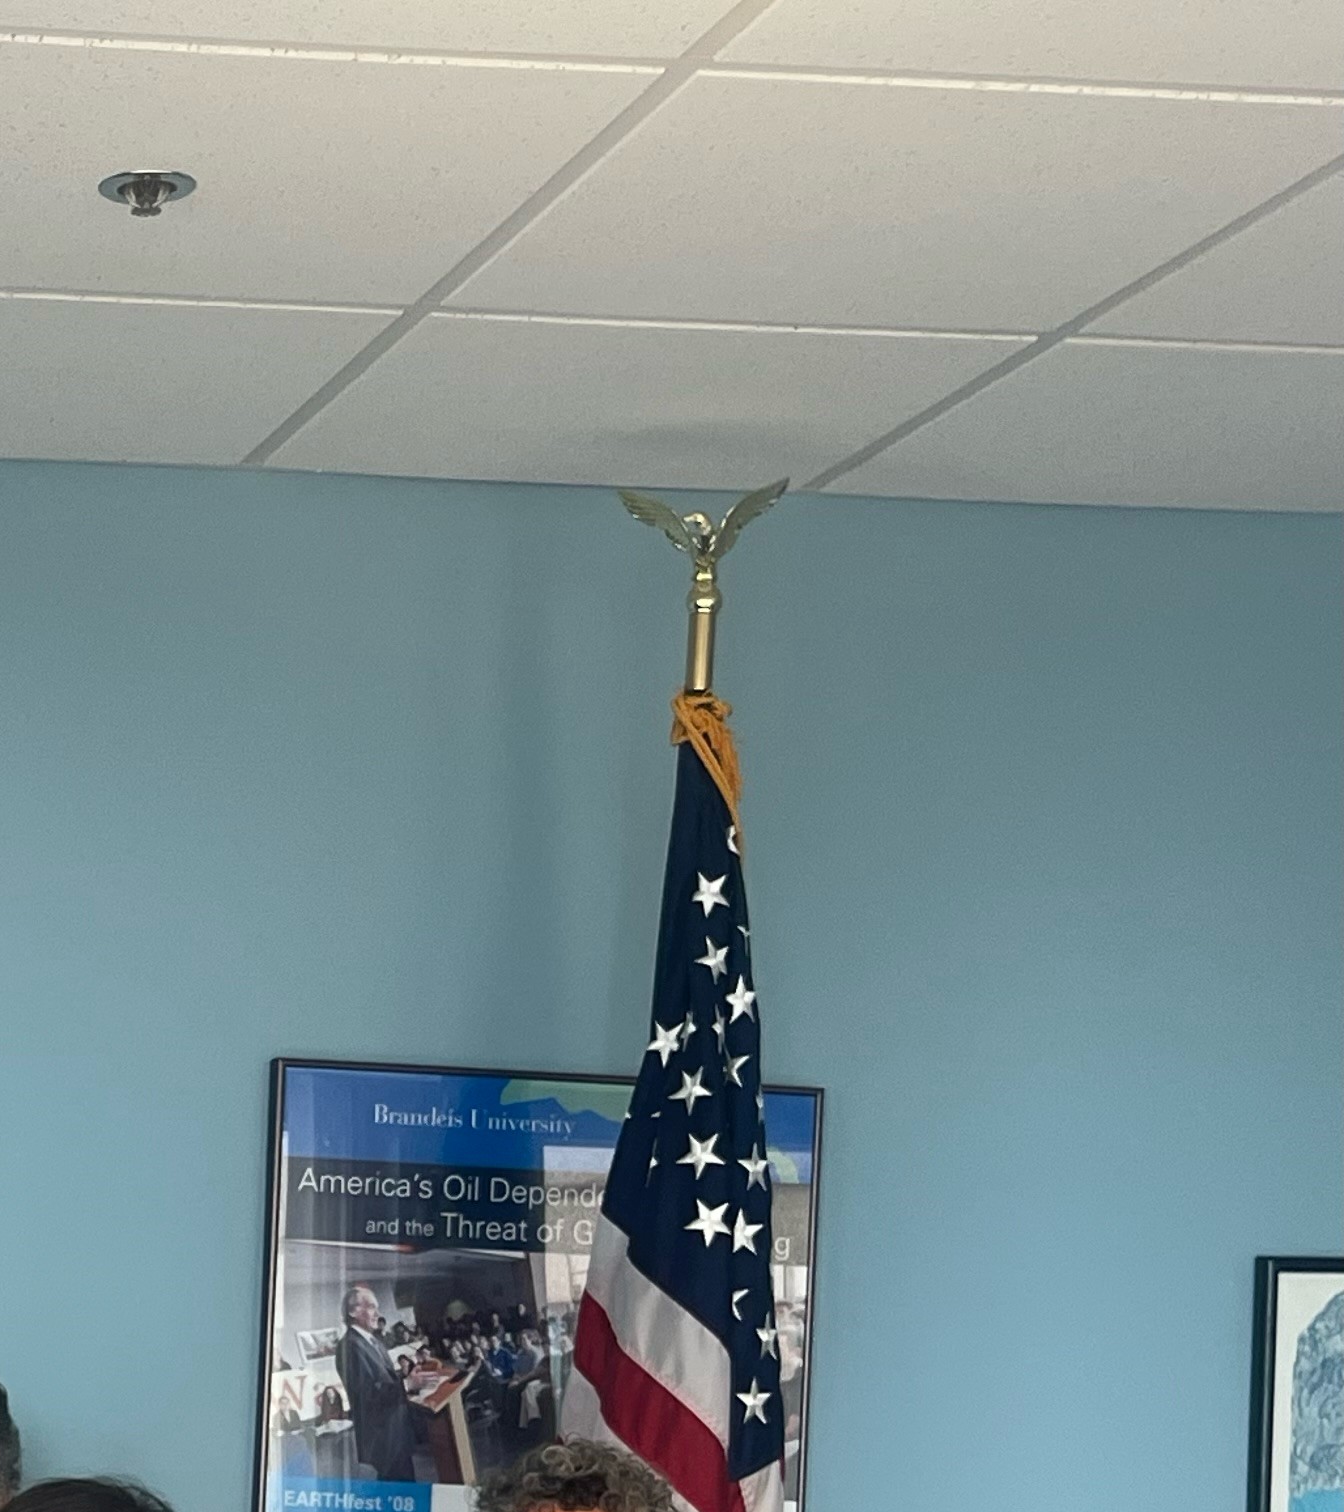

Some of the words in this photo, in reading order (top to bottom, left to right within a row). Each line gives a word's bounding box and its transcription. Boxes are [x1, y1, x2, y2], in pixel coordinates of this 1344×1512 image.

[374, 1103, 462, 1128] Brandeis
[471, 1108, 576, 1140] University
[297, 1167, 433, 1199] America's
[443, 1174, 481, 1201] Oil
[365, 1217, 399, 1236] and
[405, 1219, 435, 1238] the
[440, 1211, 528, 1243] Threat
[536, 1219, 564, 1244] of
[283, 1490, 383, 1511] EARTHfest
[387, 1496, 415, 1512] '08
